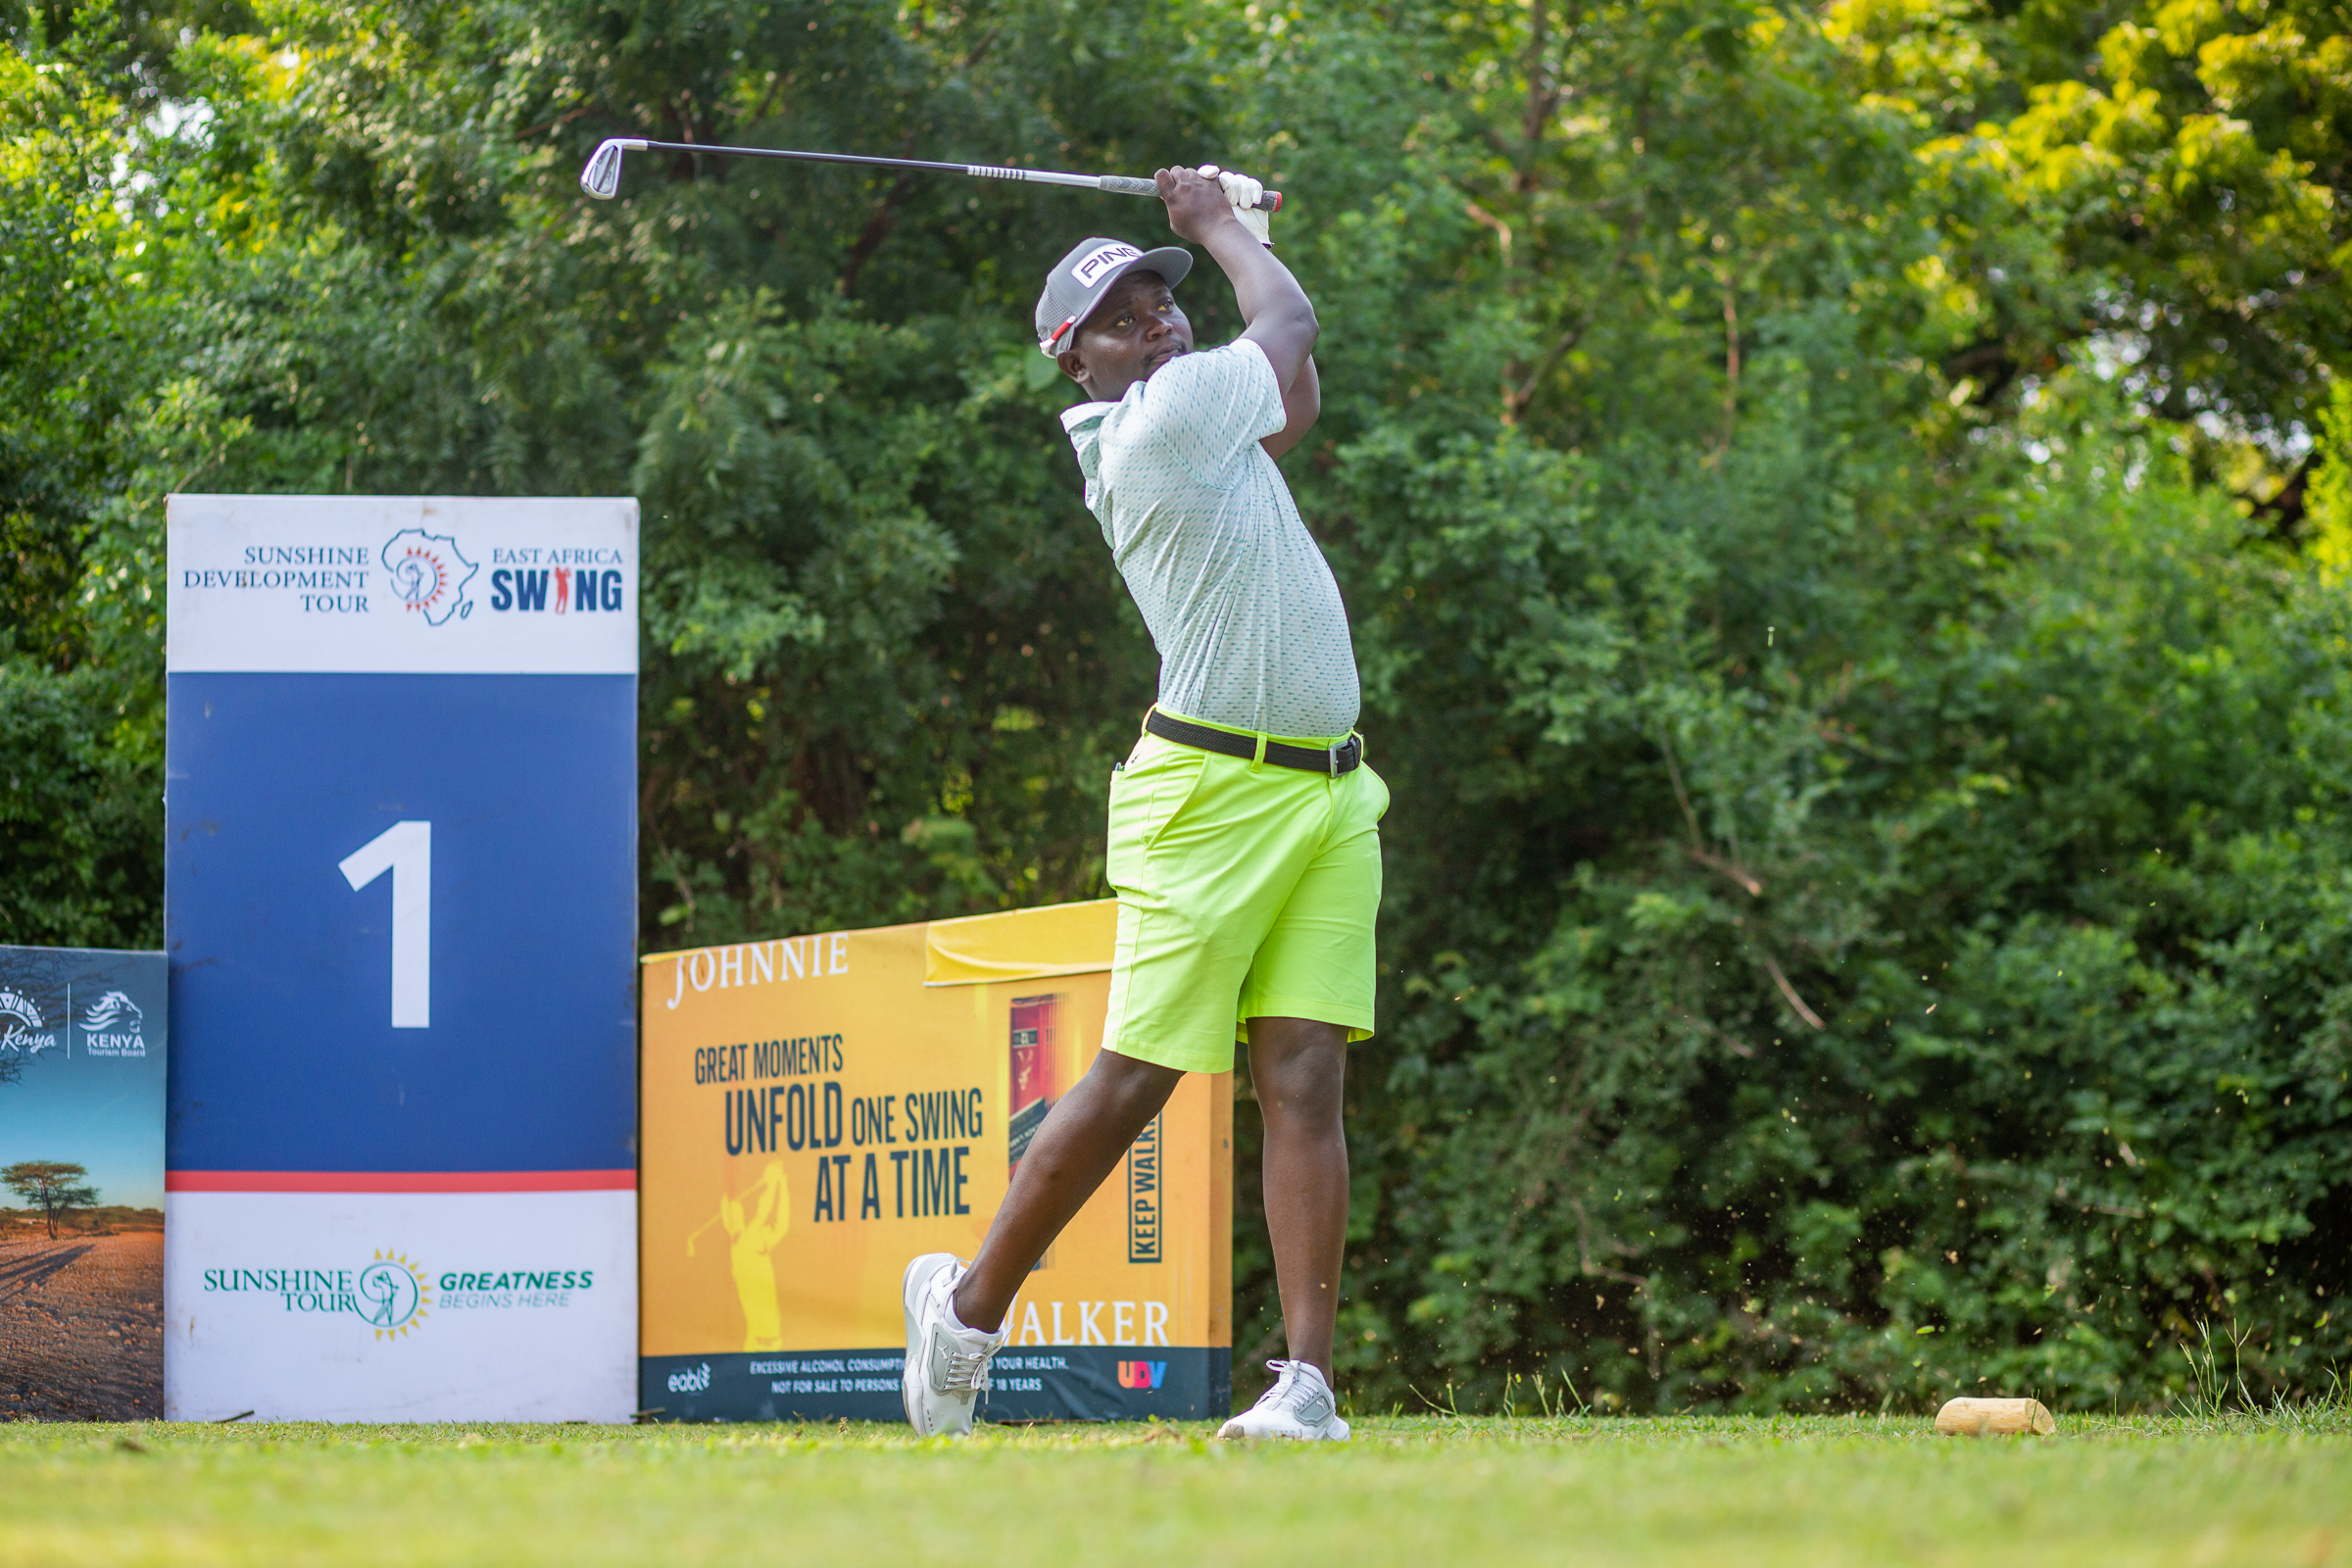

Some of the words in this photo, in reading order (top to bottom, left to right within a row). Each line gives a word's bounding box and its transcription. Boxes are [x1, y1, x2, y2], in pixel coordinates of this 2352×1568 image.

[1080, 247, 1141, 279] PING
[244, 546, 369, 565] SUNSHINE
[492, 548, 542, 564] EAST
[547, 548, 623, 564] AFRICA
[183, 570, 369, 590] DEVELOPMENT
[300, 594, 369, 613] TOUR
[337, 819, 432, 1029] 1
[666, 932, 850, 1009] JOHNNIE
[1, 1024, 57, 1054] Kenya
[86, 1033, 145, 1049] KENYA
[88, 1048, 120, 1056] Tourism
[121, 1049, 146, 1057] Board
[695, 1044, 748, 1085] GREAT
[754, 1033, 844, 1079] MOMENTS
[725, 1081, 843, 1156] UNFOLD
[851, 1095, 897, 1147] ONE
[904, 1087, 983, 1144] SWING
[813, 1154, 852, 1223] AT
[860, 1152, 881, 1220] A
[890, 1146, 970, 1218] TIME
[1134, 1199, 1156, 1255] KEEP
[204, 1269, 353, 1292] SUNSHINE
[439, 1271, 594, 1291] GREATNESS
[280, 1293, 354, 1312] TOUR
[439, 1294, 513, 1309] BEGINS
[517, 1293, 571, 1307] HERE
[750, 1360, 798, 1374] EXCESSIVE
[800, 1359, 845, 1373] ALCOHOL
[995, 1356, 1024, 1370] YOUR
[1025, 1356, 1069, 1370] HEALTH.
[1117, 1360, 1167, 1389] UDV
[771, 1380, 791, 1394] NOT
[793, 1380, 812, 1394] FOR
[814, 1379, 838, 1393] SALE
[840, 1379, 854, 1392] TO
[855, 1378, 900, 1392] PERSONS
[997, 1378, 1007, 1391] 18
[1009, 1378, 1042, 1391] YEARS
